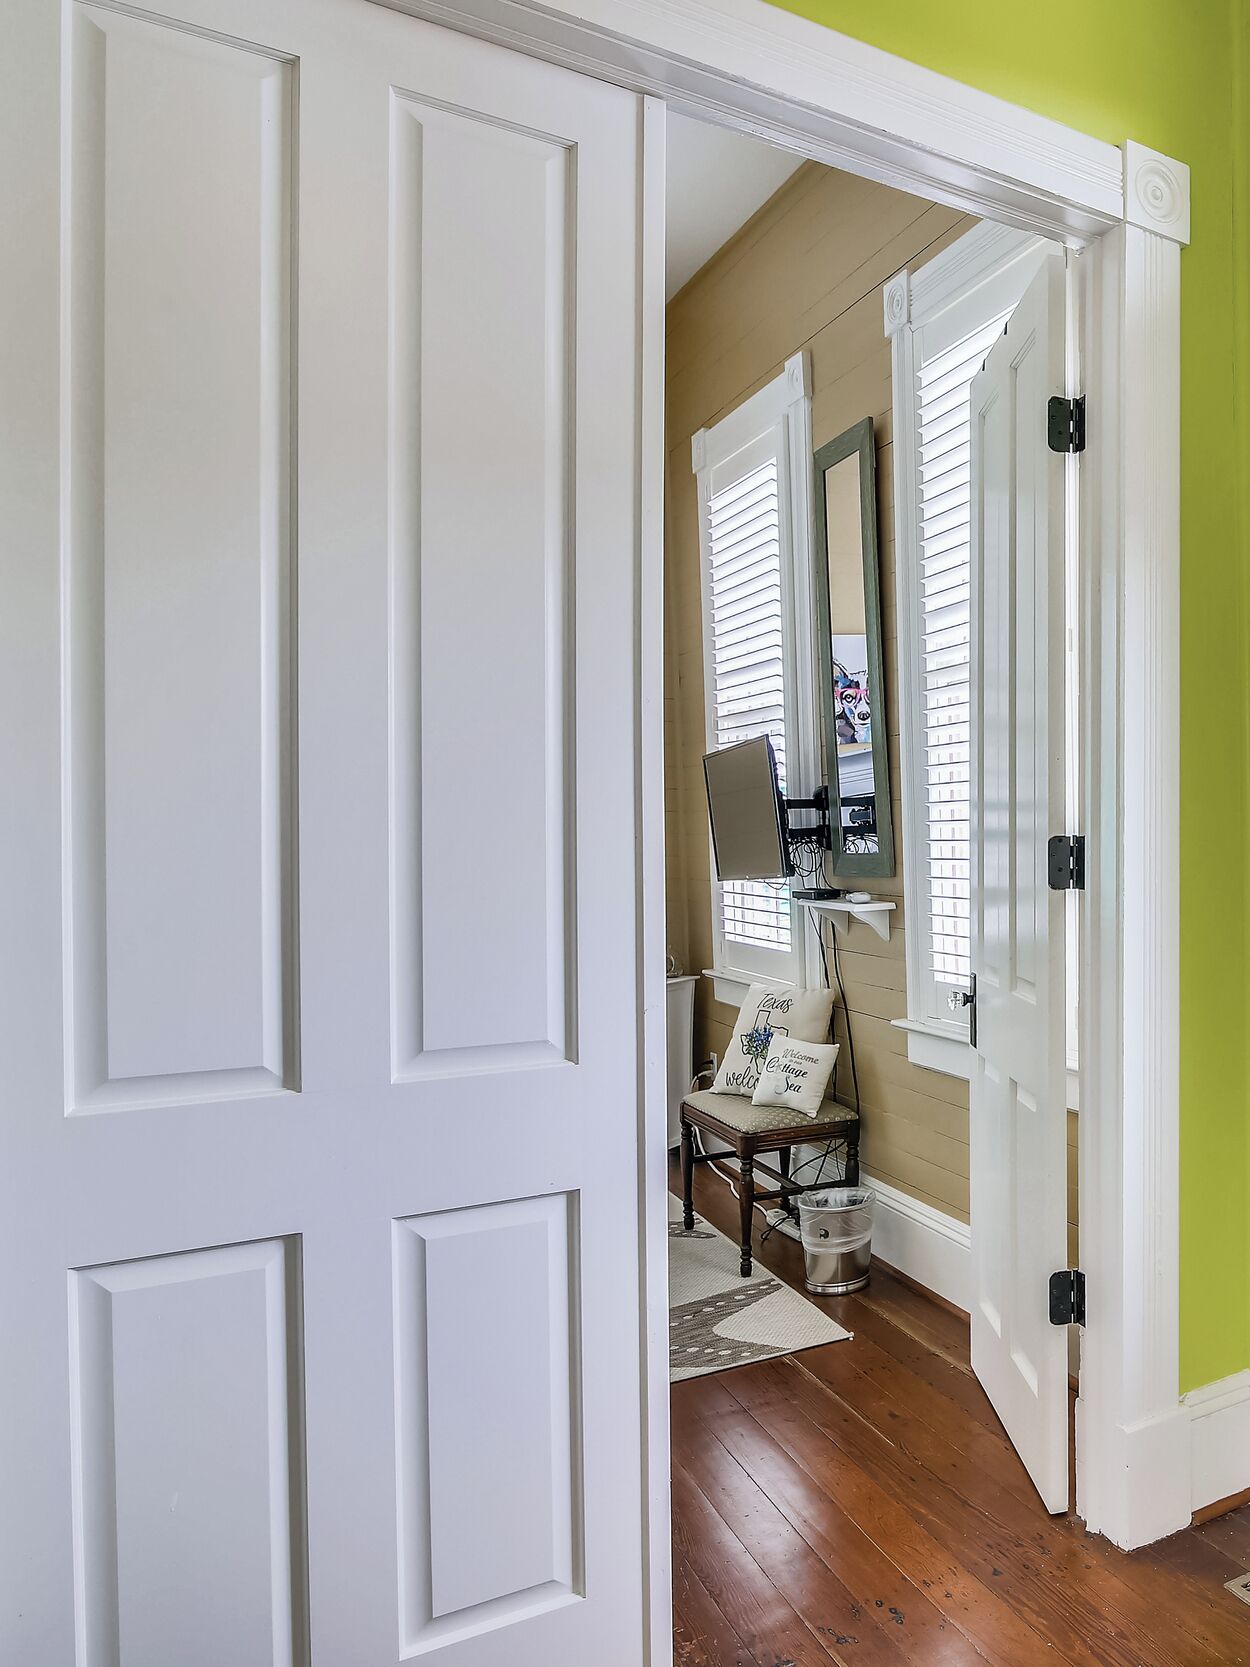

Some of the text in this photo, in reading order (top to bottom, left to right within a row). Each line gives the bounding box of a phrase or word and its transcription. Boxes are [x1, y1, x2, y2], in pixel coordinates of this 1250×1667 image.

[757, 993, 794, 1014] Texas
[782, 1048, 820, 1065] Welcome
[766, 1056, 808, 1078] Cttage
[774, 1075, 802, 1095] Sea
